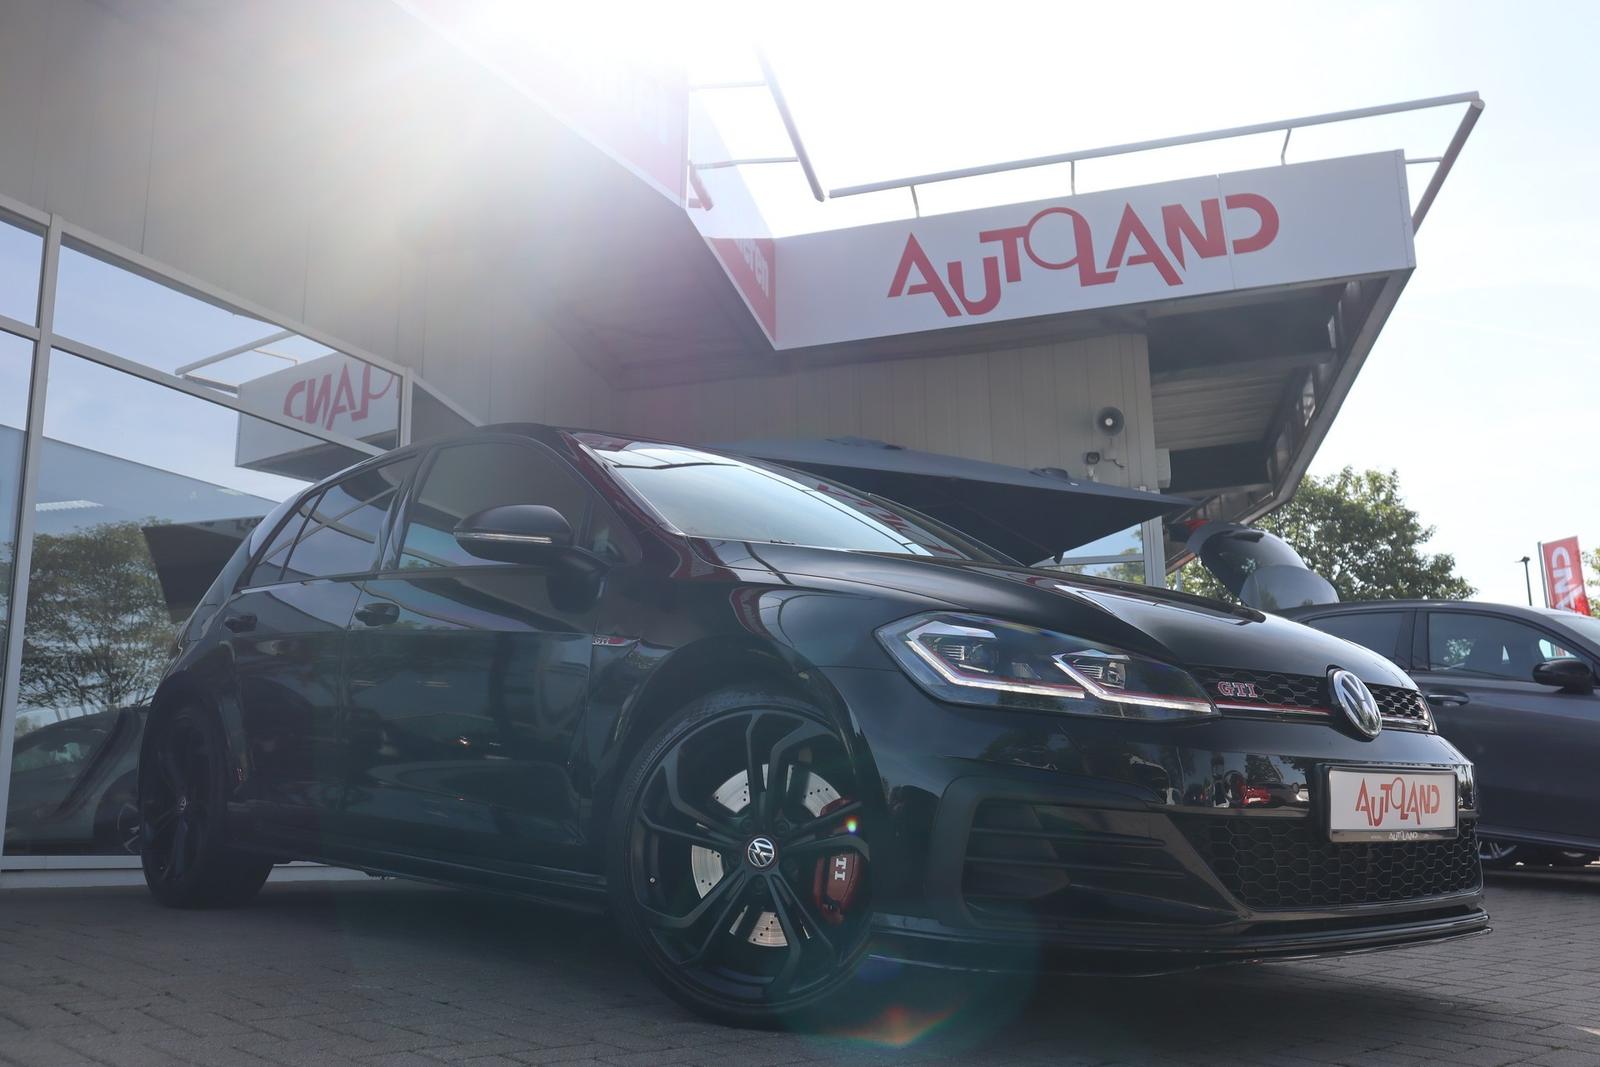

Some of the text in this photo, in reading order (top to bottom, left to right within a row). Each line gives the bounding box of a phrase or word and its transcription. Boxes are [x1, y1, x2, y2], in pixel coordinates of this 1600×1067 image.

[887, 193, 1280, 317] AUTOLAND
[1217, 681, 1258, 698] GTI
[1355, 776, 1440, 827] AUTOLAND
[834, 857, 847, 881] TI
